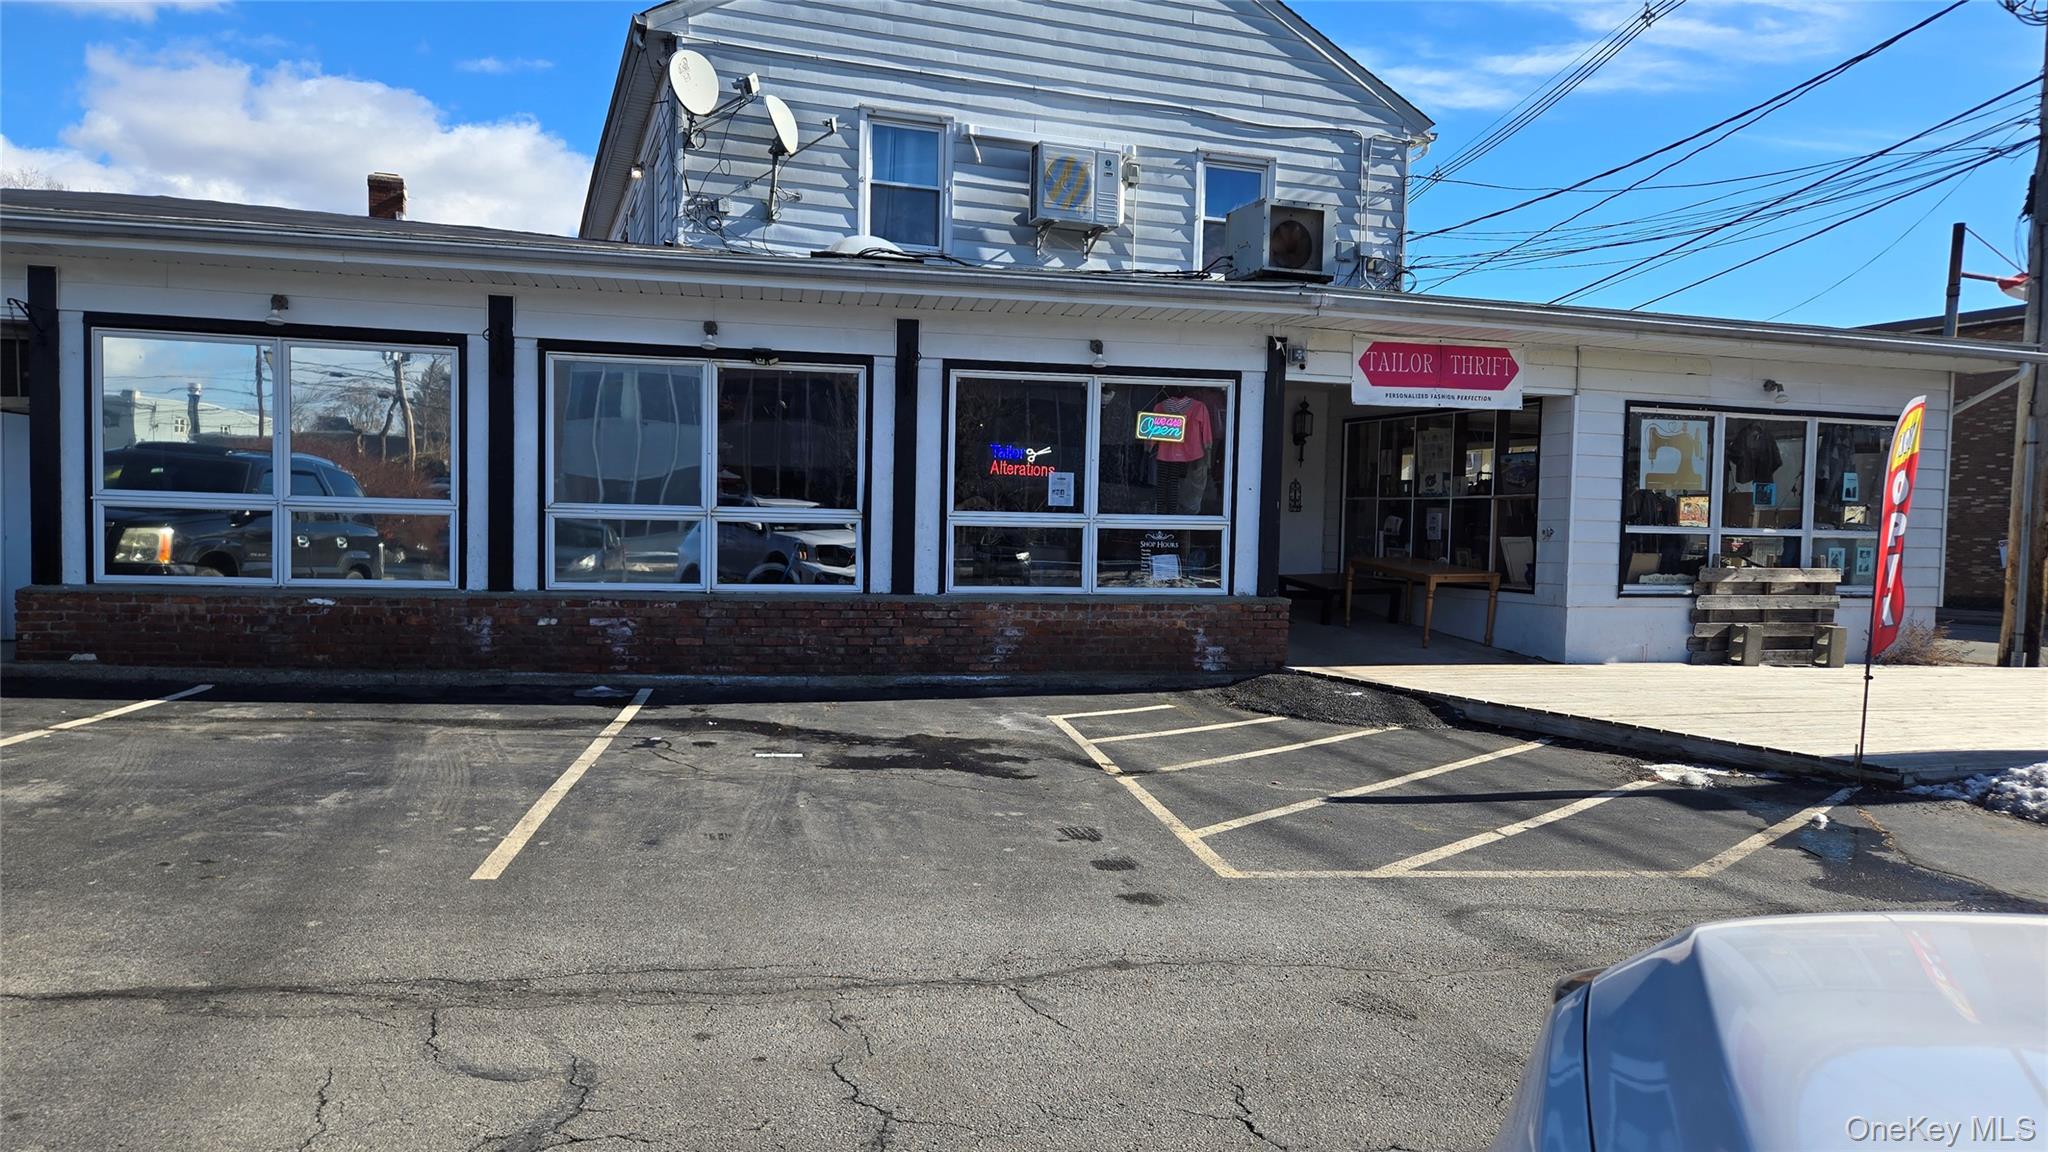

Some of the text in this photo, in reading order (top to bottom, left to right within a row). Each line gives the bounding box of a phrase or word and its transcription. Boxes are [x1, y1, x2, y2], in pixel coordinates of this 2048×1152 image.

[1366, 351, 1512, 377] TAILOR THRIFT
[1385, 392, 1492, 402] PERSONALIZED FASHION PERFECTION
[1140, 416, 1182, 438] Open
[990, 443, 1025, 459] Tailor
[990, 459, 1056, 477] Alterations
